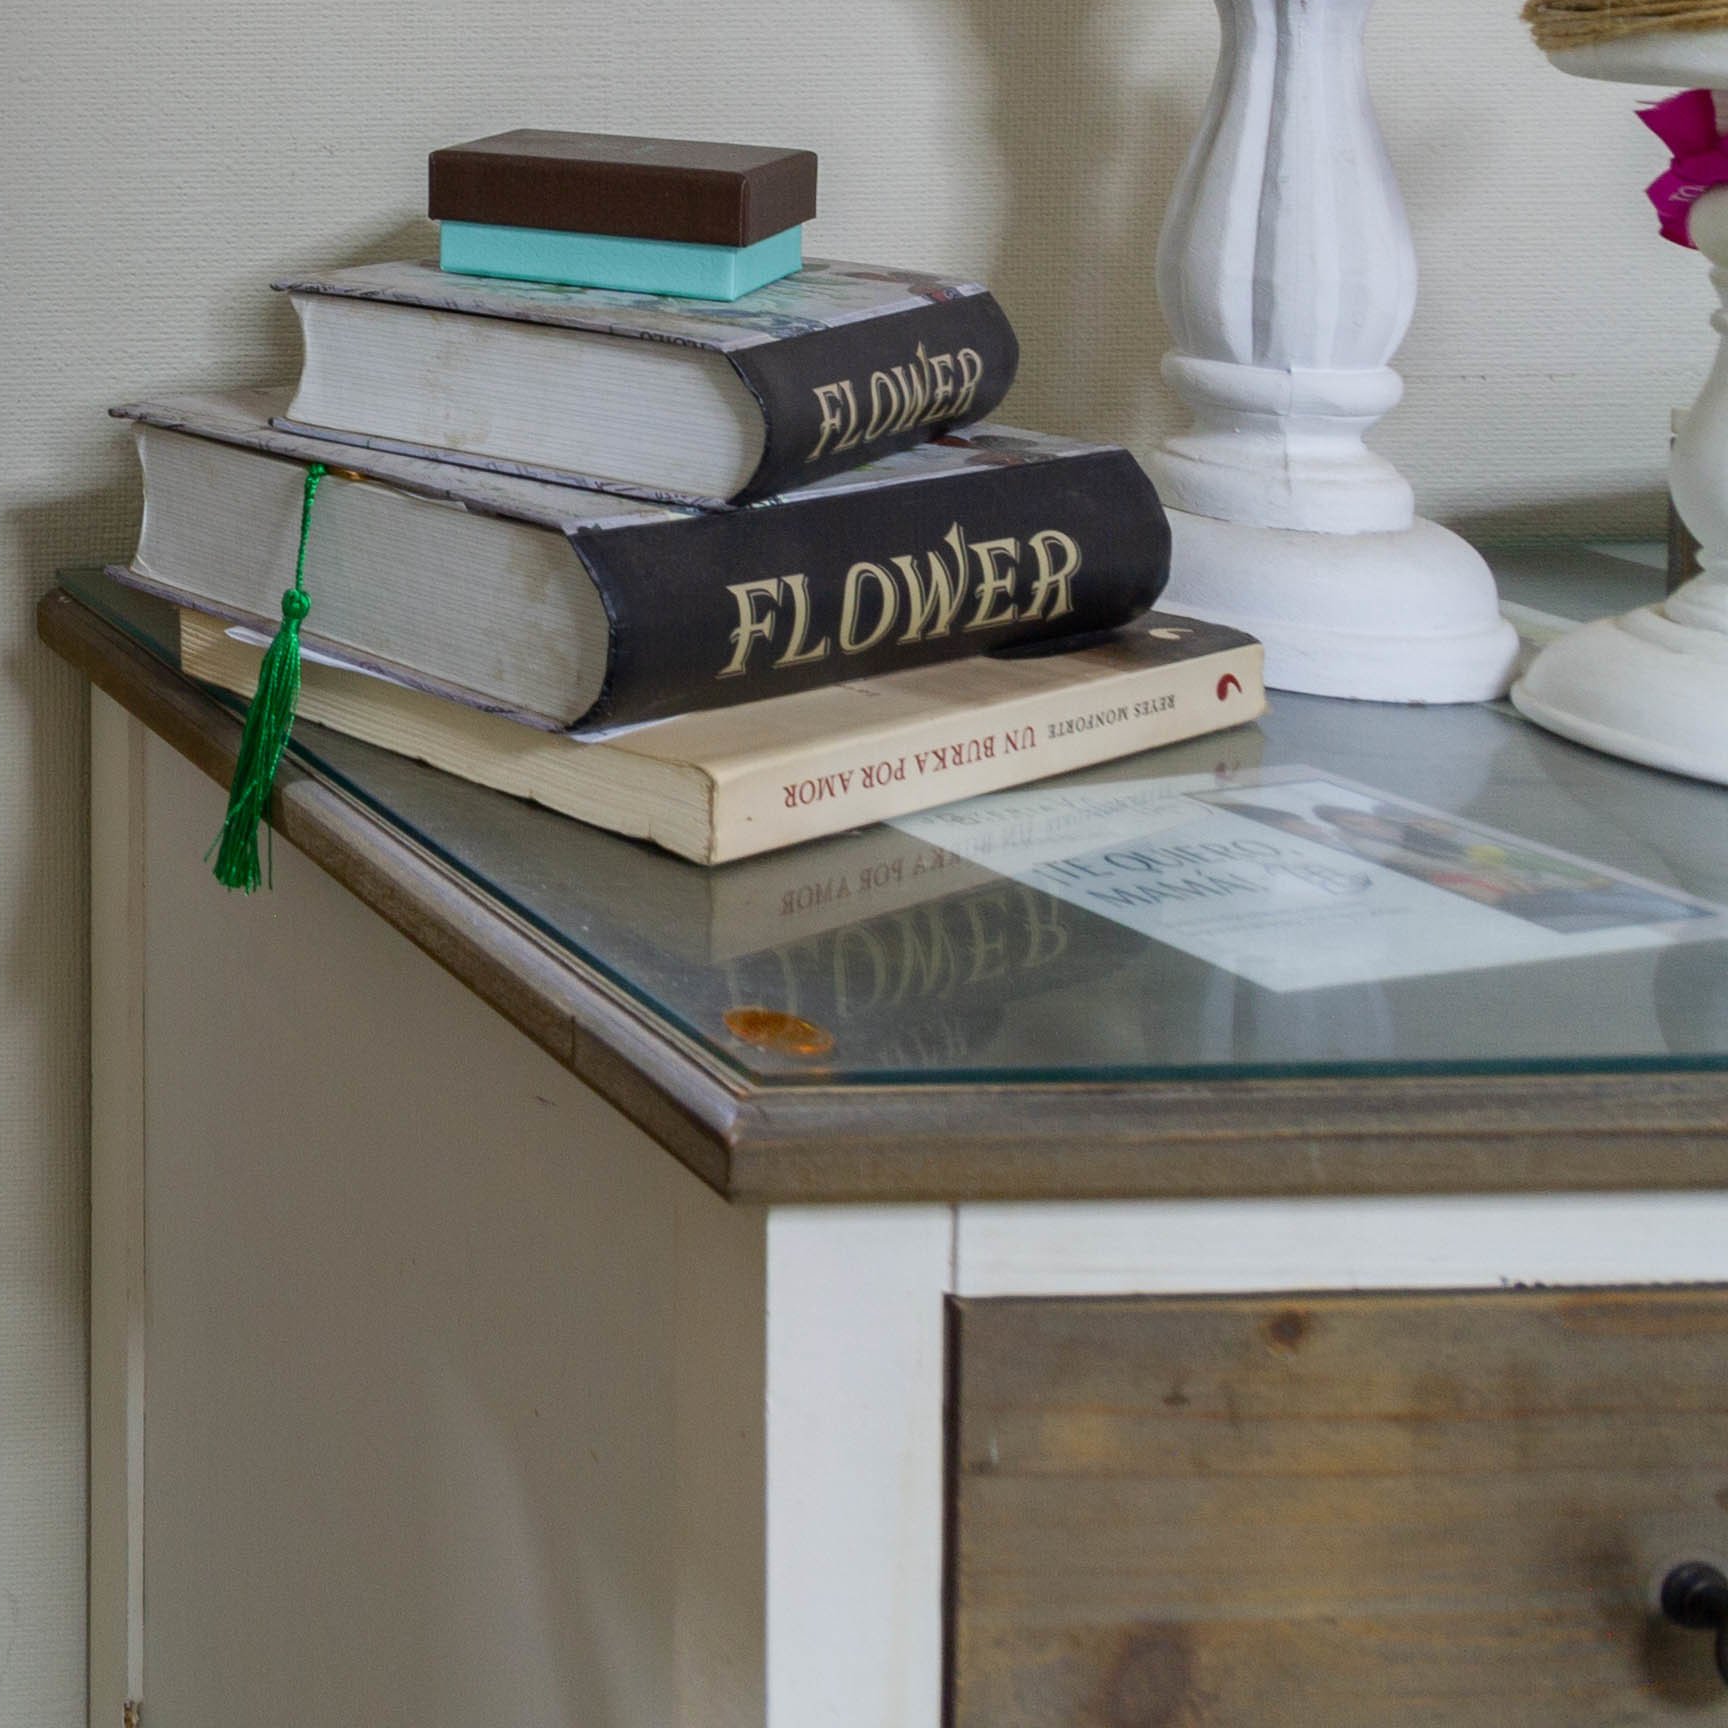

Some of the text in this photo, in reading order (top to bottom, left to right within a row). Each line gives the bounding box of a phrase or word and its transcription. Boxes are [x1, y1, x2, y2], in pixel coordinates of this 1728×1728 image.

[804, 340, 984, 464] FLOWER
[714, 521, 1083, 679] FLOWER
[782, 724, 1036, 810] UN BURKA POR AMOR
[1047, 693, 1176, 740] REYES MONFORTE
